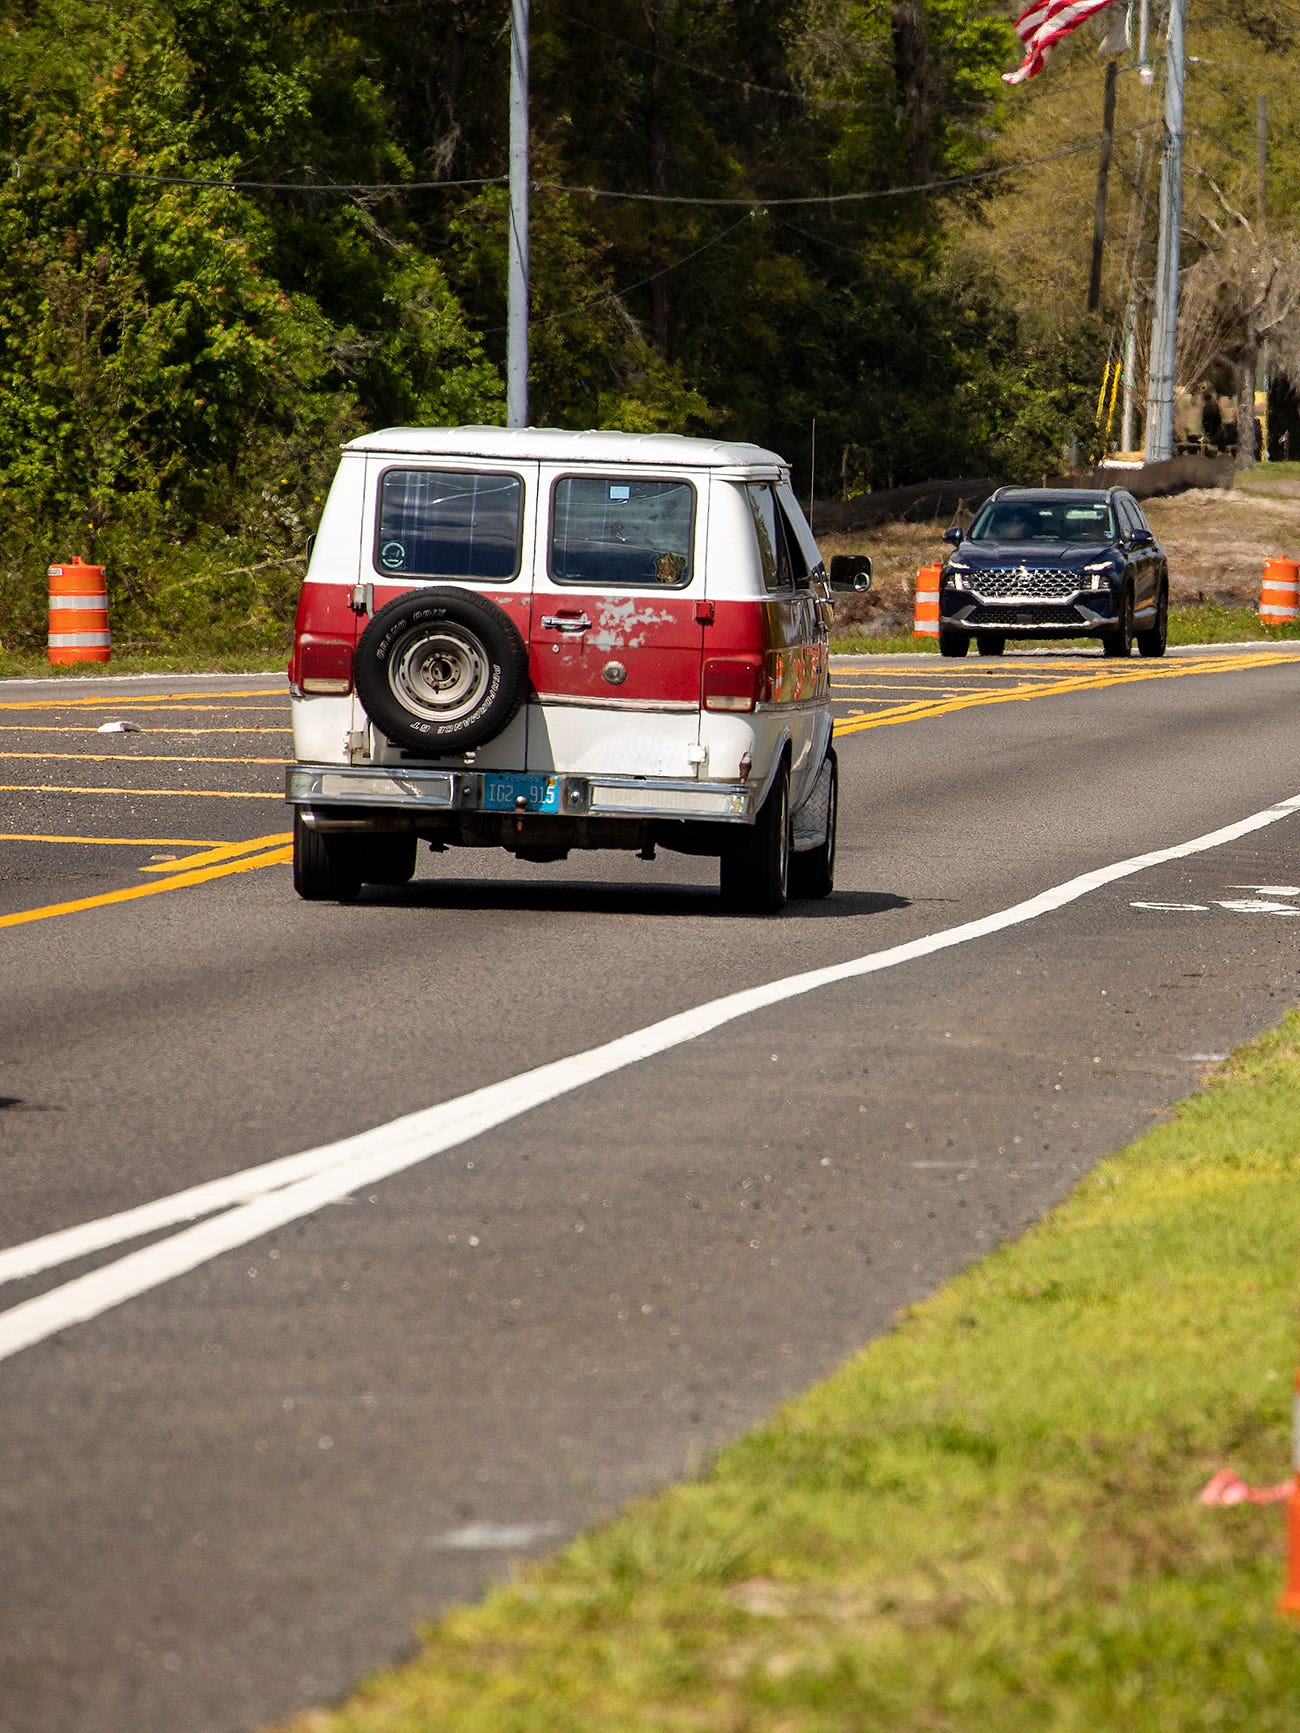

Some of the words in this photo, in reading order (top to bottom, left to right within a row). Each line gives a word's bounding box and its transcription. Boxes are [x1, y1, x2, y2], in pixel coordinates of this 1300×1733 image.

[376, 619, 407, 660] GRAND
[413, 608, 447, 620] PRIX
[436, 664, 501, 735] PERFORMANCE
[410, 721, 432, 733] GT
[489, 784, 514, 802] IG2
[530, 785, 555, 804] 915
